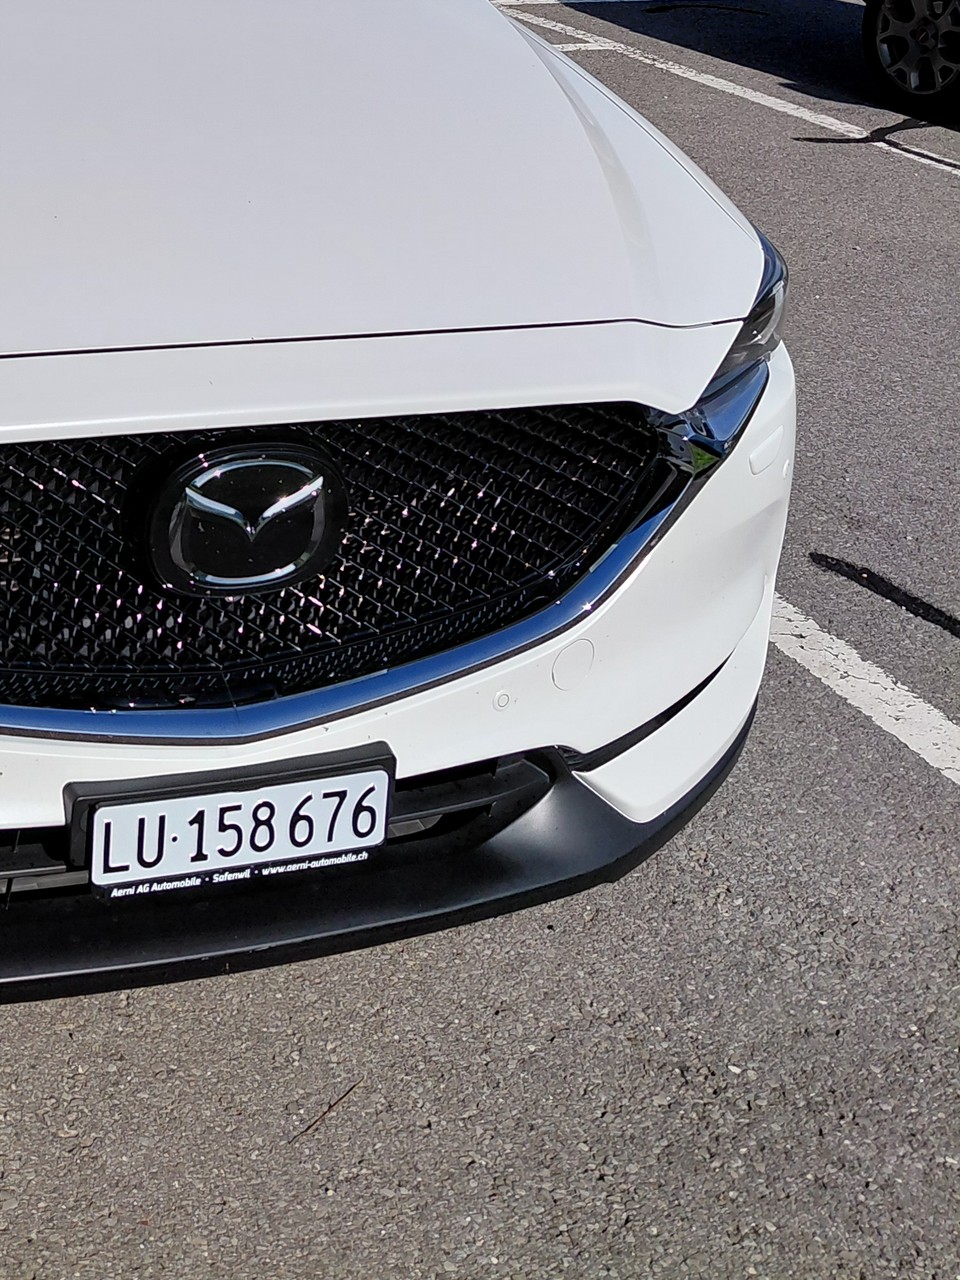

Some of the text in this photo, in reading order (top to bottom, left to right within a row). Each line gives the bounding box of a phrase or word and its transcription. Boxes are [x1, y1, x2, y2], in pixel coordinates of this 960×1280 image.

[110, 850, 369, 898] Aerni AG Automobile Safenwil www.aerni-automobile.ch
